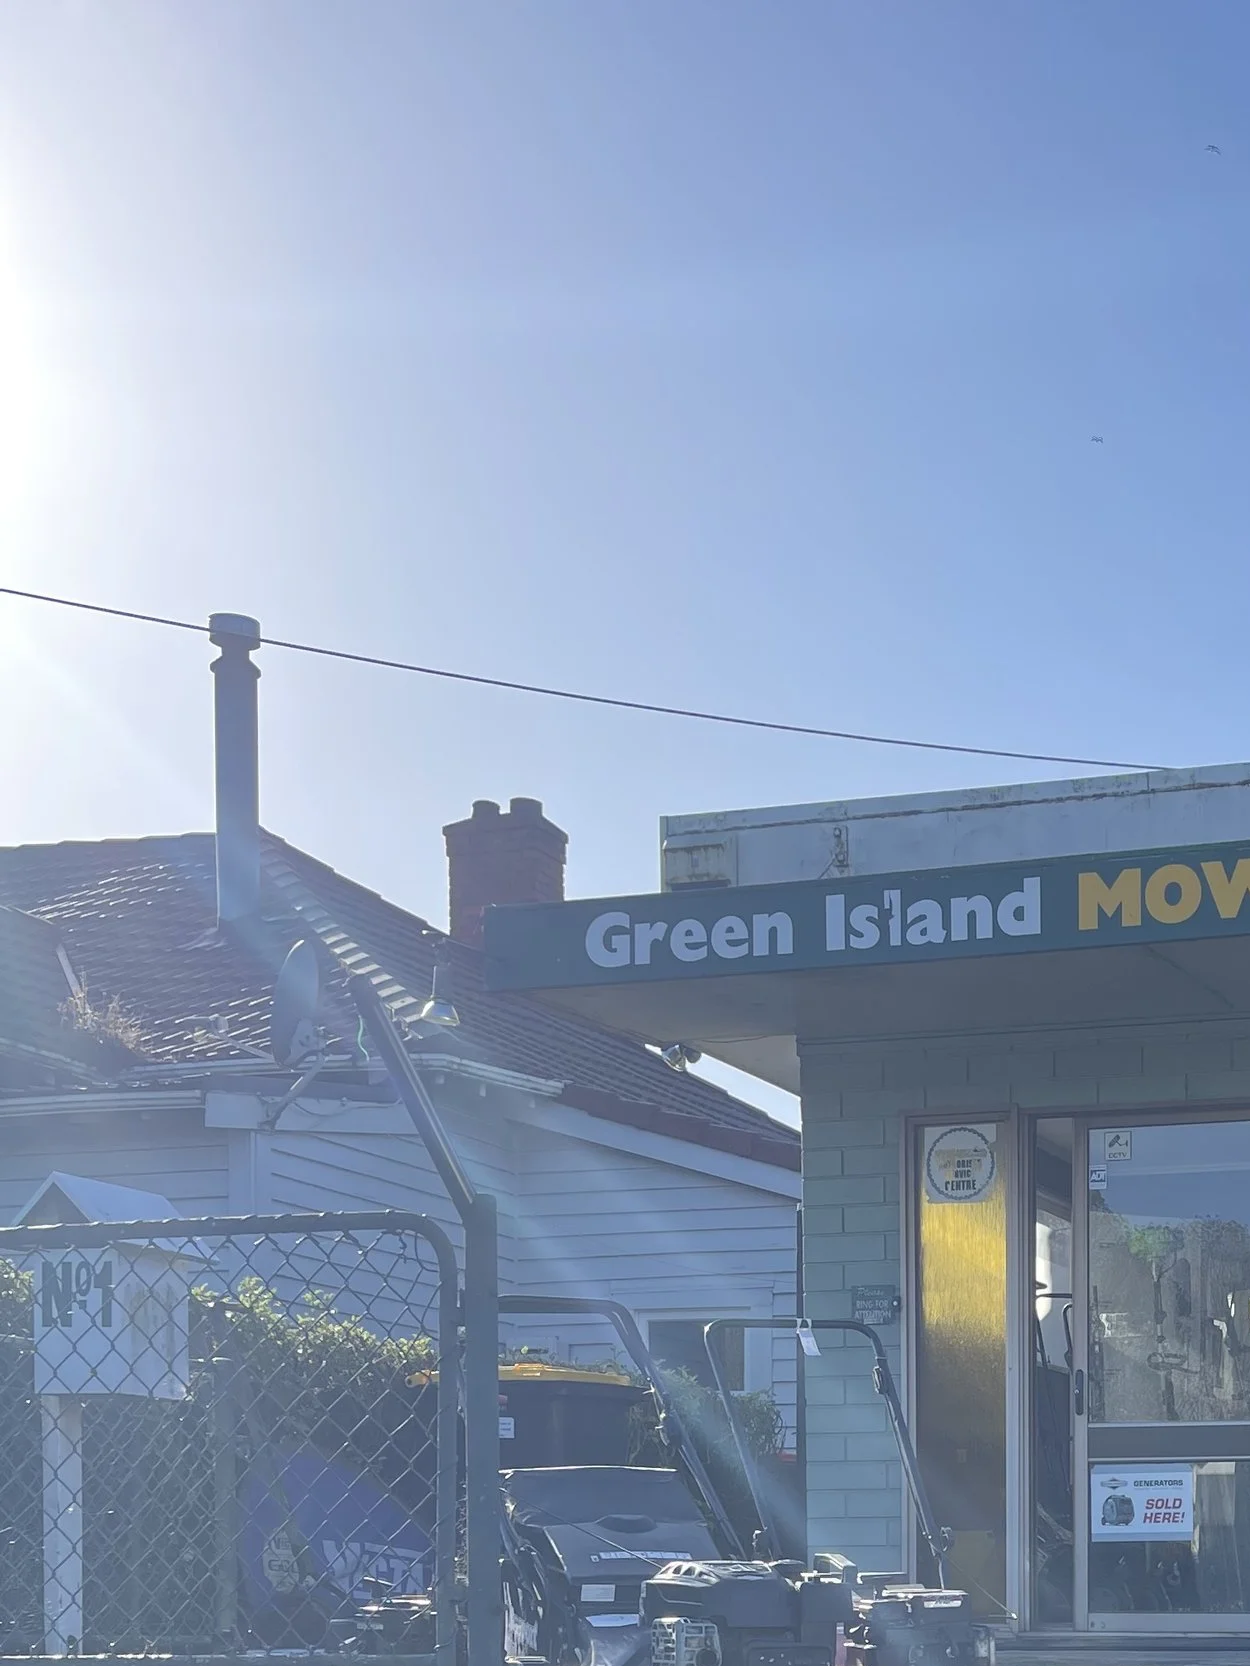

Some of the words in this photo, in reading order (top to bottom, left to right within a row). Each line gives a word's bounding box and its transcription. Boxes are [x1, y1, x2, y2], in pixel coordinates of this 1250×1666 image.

[585, 911, 794, 970] Green
[824, 876, 1042, 951] Island
[1091, 1170, 1105, 1182] ADT
[875, 1300, 889, 1308] FOR
[1133, 1479, 1184, 1487] GENERATORS
[1145, 1498, 1183, 1510] SOLD
[1143, 1511, 1185, 1524] HERE!
